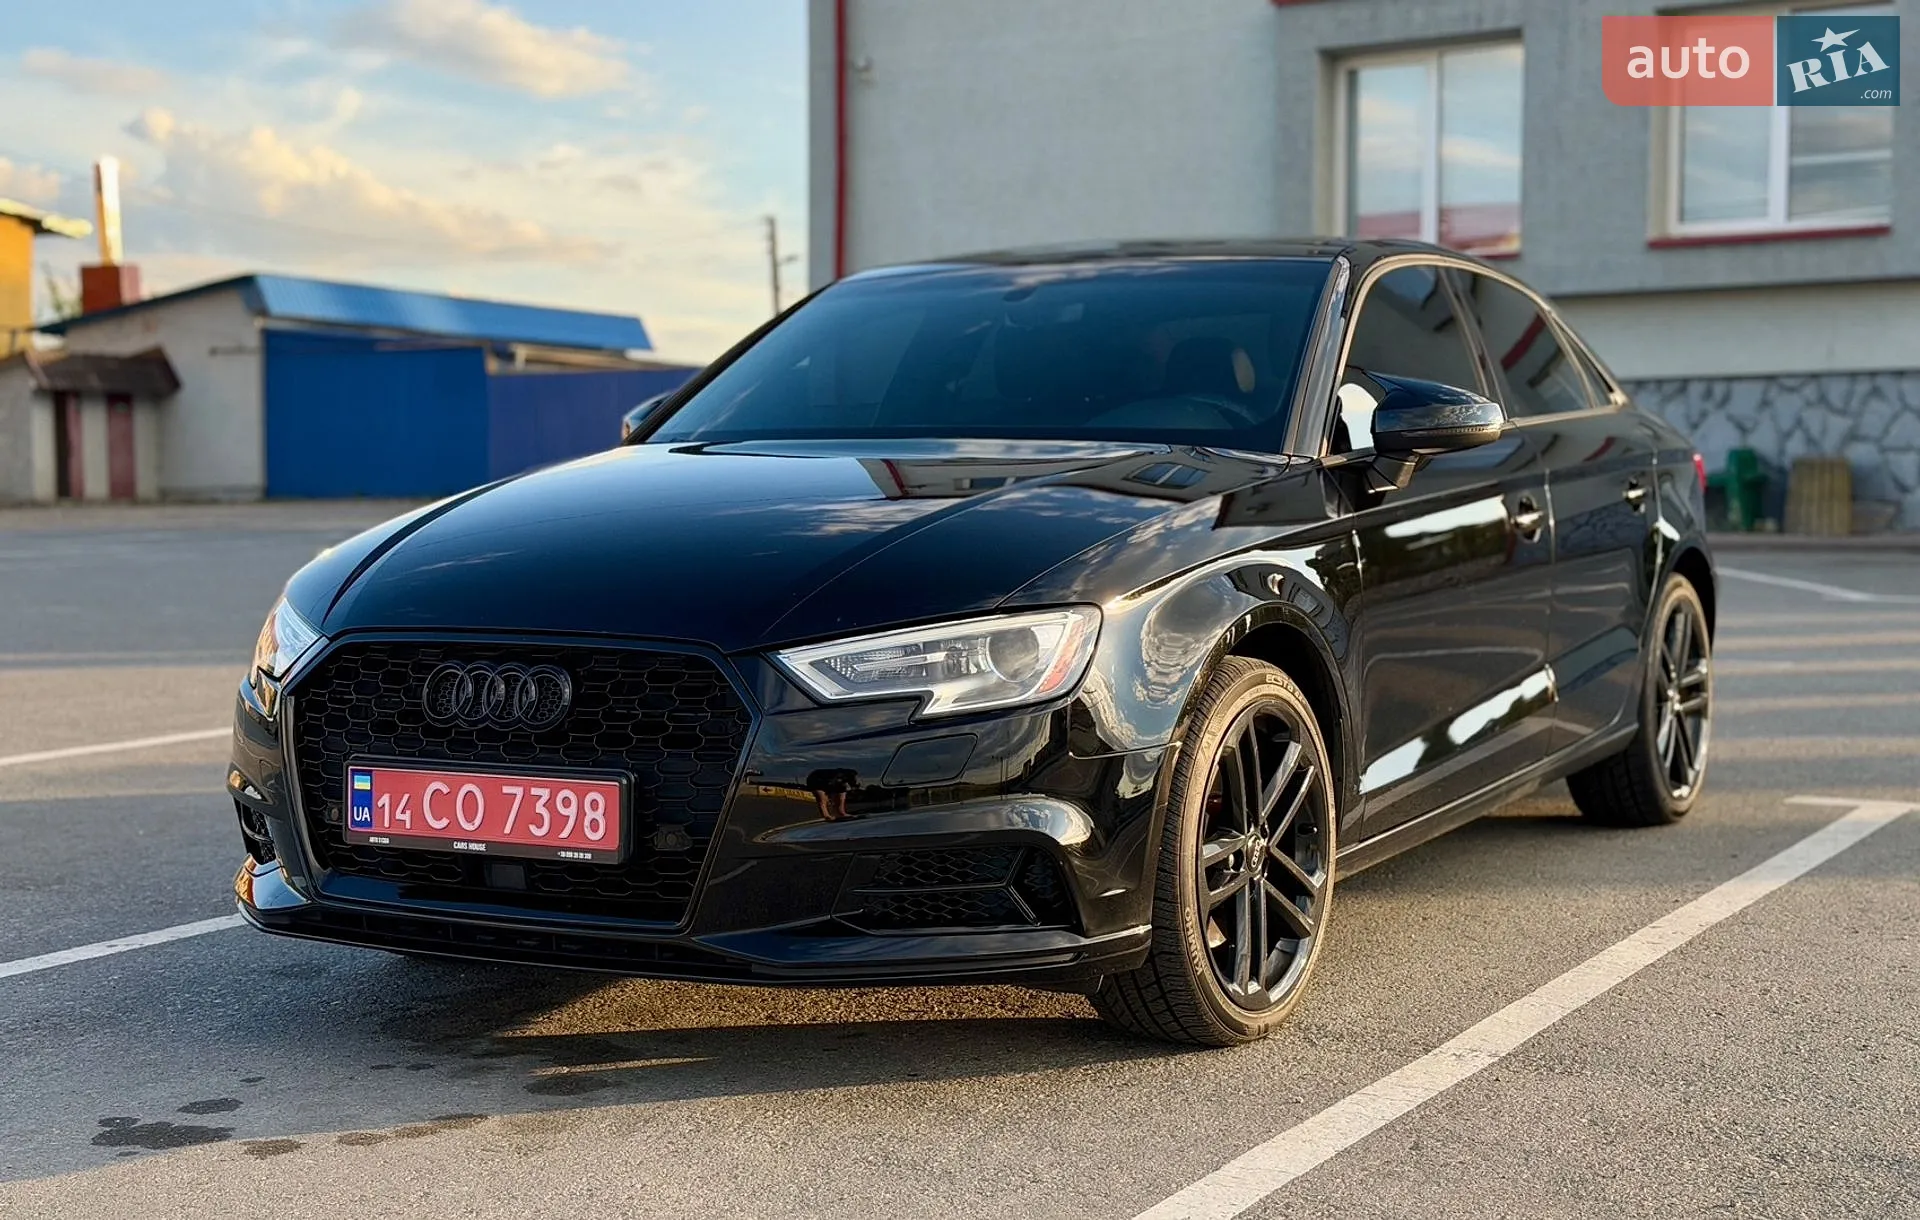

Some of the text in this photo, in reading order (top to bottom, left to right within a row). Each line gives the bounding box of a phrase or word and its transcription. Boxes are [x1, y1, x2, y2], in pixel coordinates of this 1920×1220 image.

[353, 806, 371, 822] UA
[377, 781, 606, 841] 14 CO 7398
